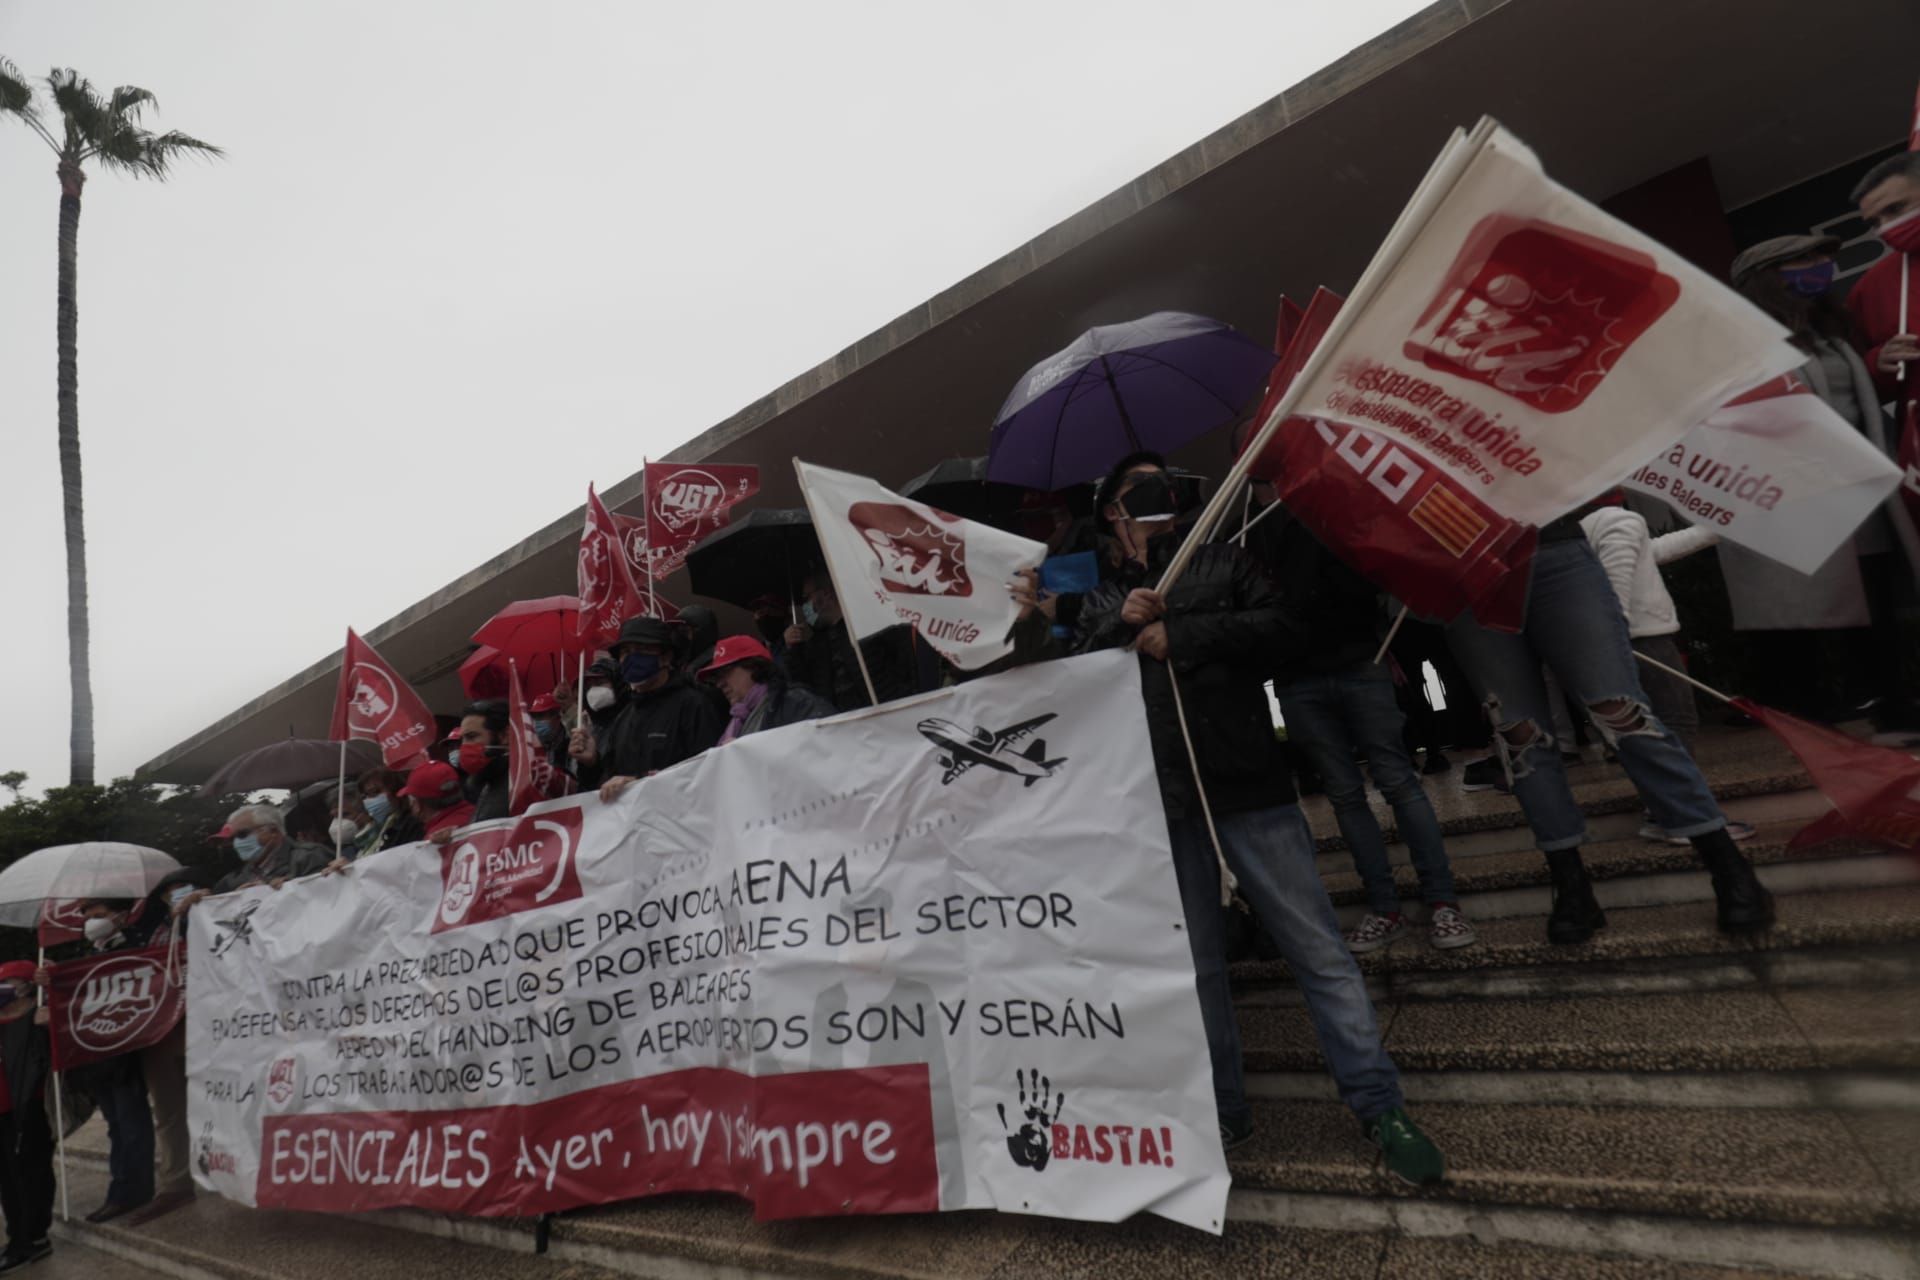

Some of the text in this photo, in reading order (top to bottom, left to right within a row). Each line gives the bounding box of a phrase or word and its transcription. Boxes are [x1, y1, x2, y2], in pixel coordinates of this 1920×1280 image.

[661, 481, 719, 512] UGT
[1670, 479, 1736, 526] Balears
[1687, 454, 1785, 512] unida
[353, 969, 375, 992] LA
[514, 918, 585, 963] QUE
[598, 885, 724, 941] PROVOCA
[729, 855, 851, 907] AENA
[83, 965, 156, 1007] UGT
[372, 990, 459, 1025] DERECHOS
[576, 917, 808, 987] PROFESIONALES
[826, 908, 901, 947] DEL
[916, 892, 1077, 934] SECTOR
[588, 989, 637, 1026] DE
[650, 968, 751, 1010] BALEARES
[303, 1073, 341, 1100] LOS
[512, 1056, 536, 1086] DE
[547, 1038, 621, 1081] LOS
[636, 1014, 809, 1057] AEROPUERTOS
[827, 1003, 924, 1045] SON
[939, 999, 965, 1036] Y
[980, 998, 1125, 1039] SERÁN
[271, 1124, 491, 1189] ESENCIALES
[641, 1104, 713, 1167] hoy
[1051, 1123, 1174, 1169] BASTA!
